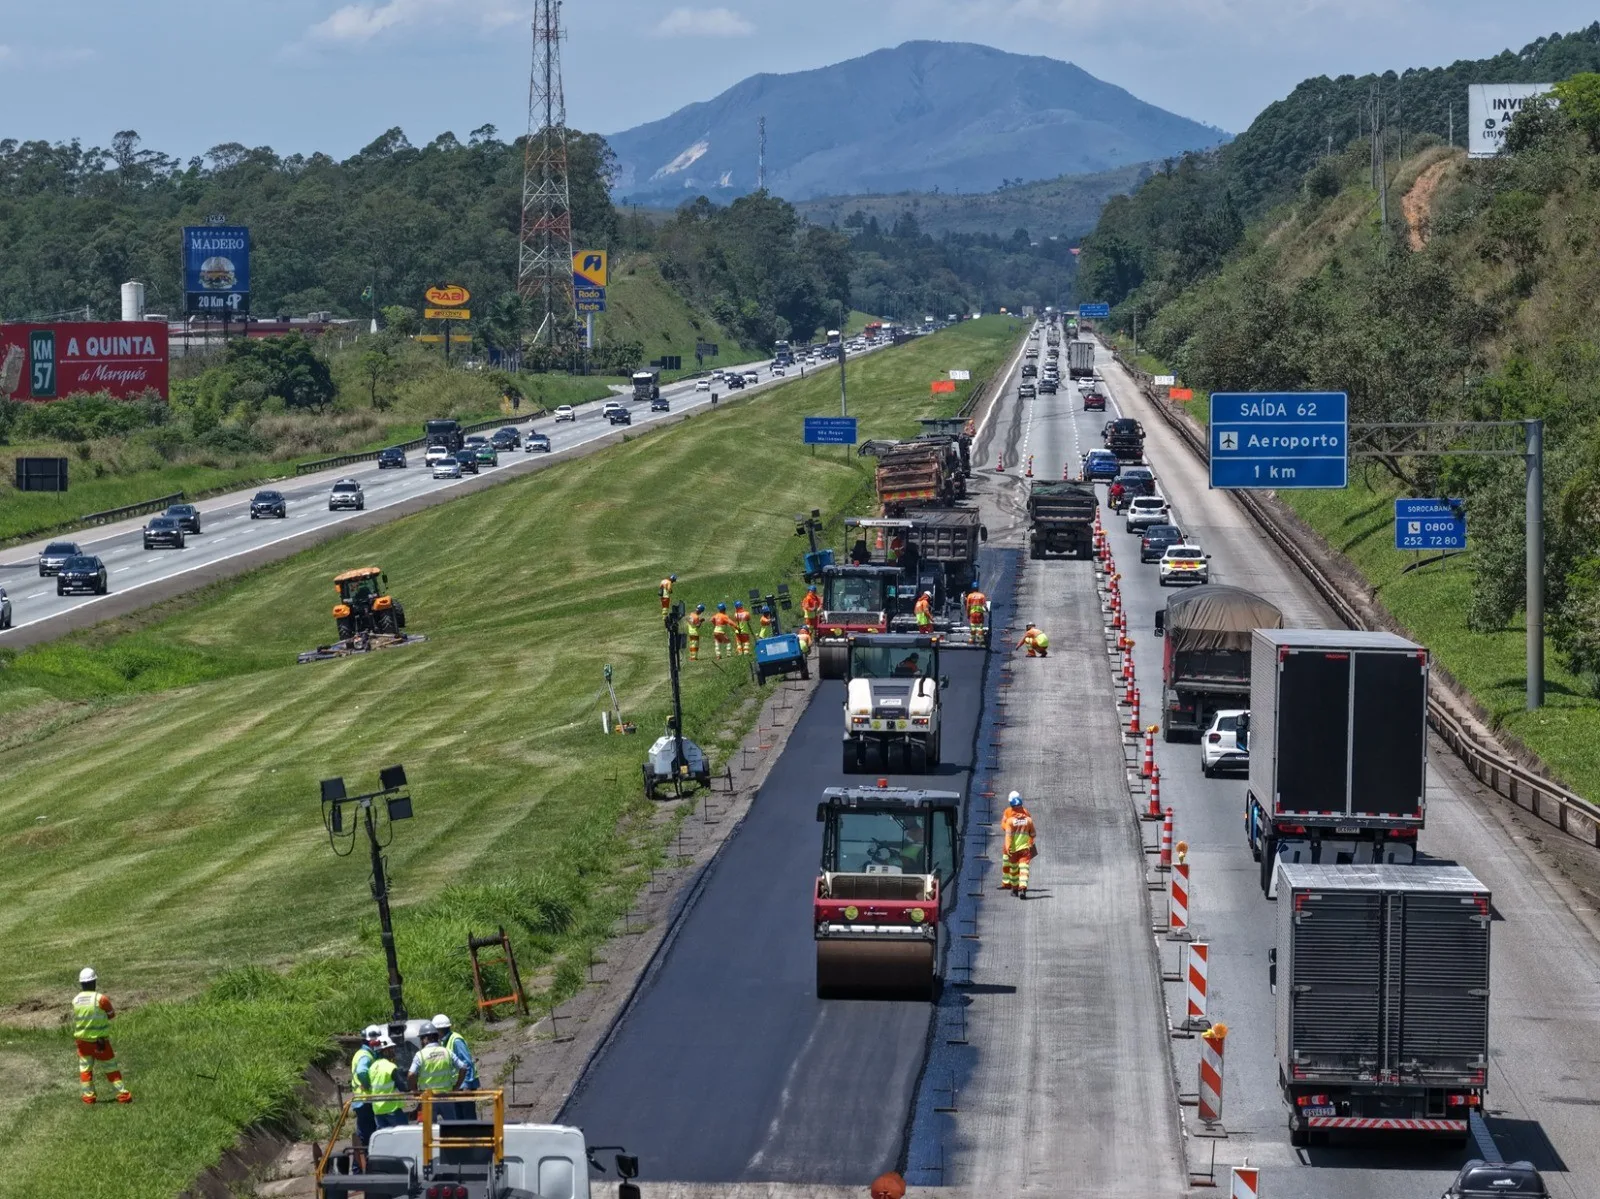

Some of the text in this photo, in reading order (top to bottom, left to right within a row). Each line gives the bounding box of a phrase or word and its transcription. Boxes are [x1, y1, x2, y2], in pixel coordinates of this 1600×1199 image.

[191, 239, 245, 249] MADERO
[198, 296, 224, 307] 20 Km
[33, 340, 53, 360] KM
[66, 336, 156, 357] A QUINTA
[34, 362, 53, 389] 57
[78, 364, 147, 386] do Marquês
[1240, 398, 1318, 417] SAÍDA 62
[1247, 433, 1339, 450] Aeroporto
[1254, 465, 1296, 478] 1 km
[1424, 523, 1454, 532] 0800
[1403, 536, 1457, 546] 252 7280
